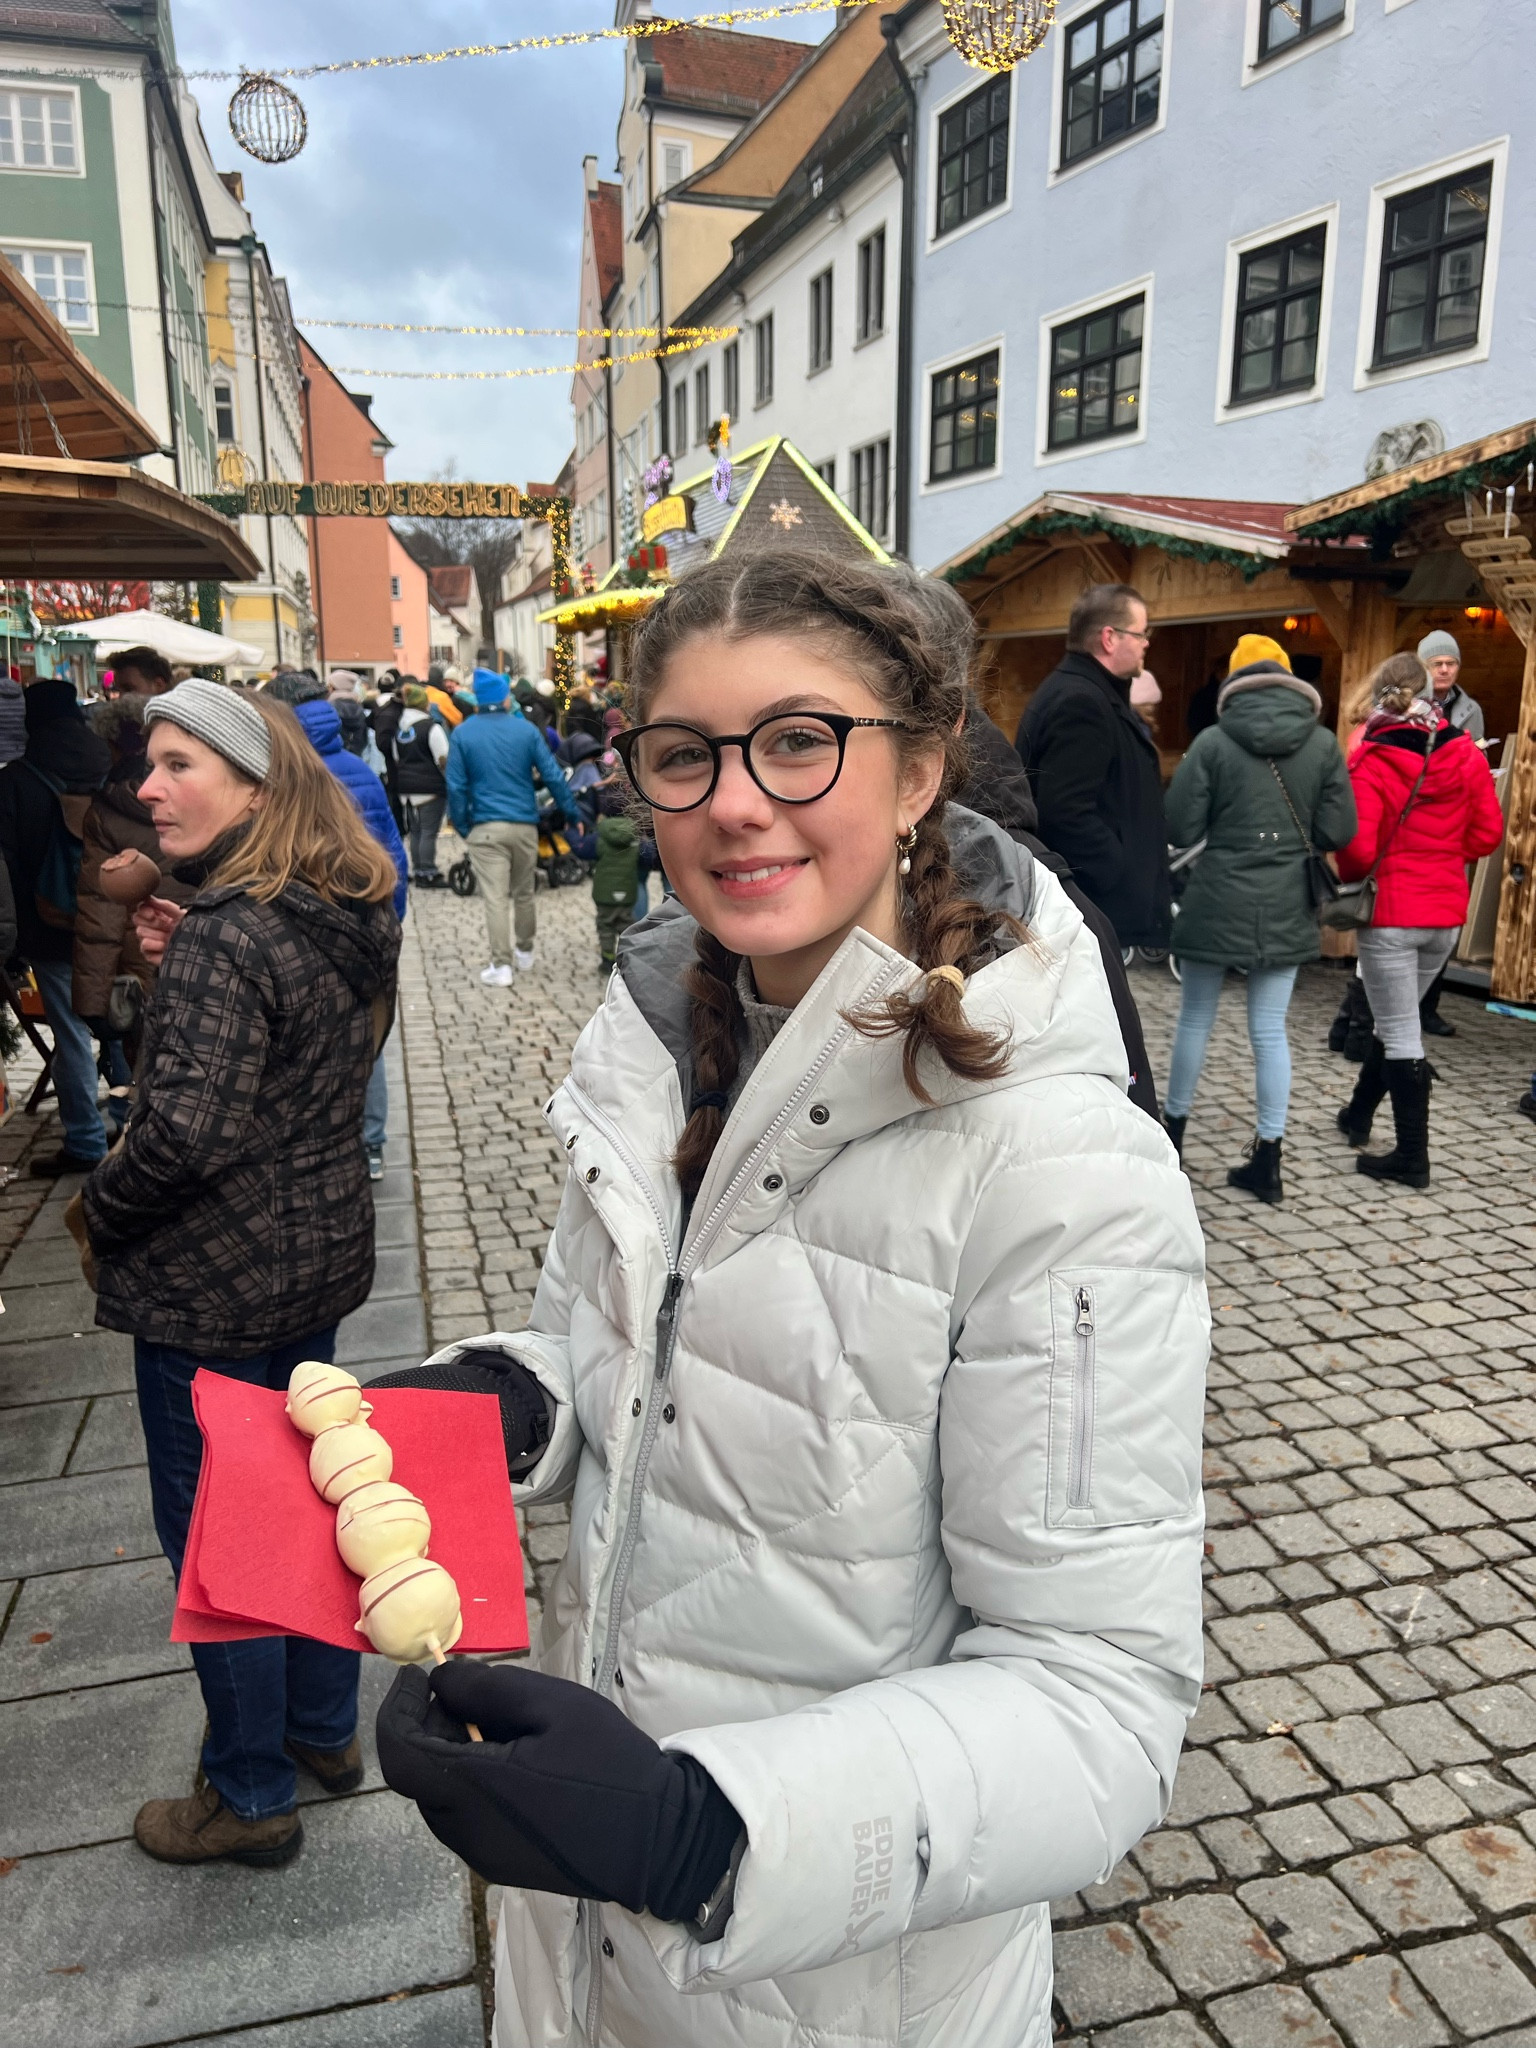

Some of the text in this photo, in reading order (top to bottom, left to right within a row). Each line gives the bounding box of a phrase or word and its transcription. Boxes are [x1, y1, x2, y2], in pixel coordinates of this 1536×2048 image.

[245, 480, 521, 517] AUF WIEDERSEHEN
[850, 1820, 873, 1917] BAUER
[871, 1816, 893, 1904] EDDIE
